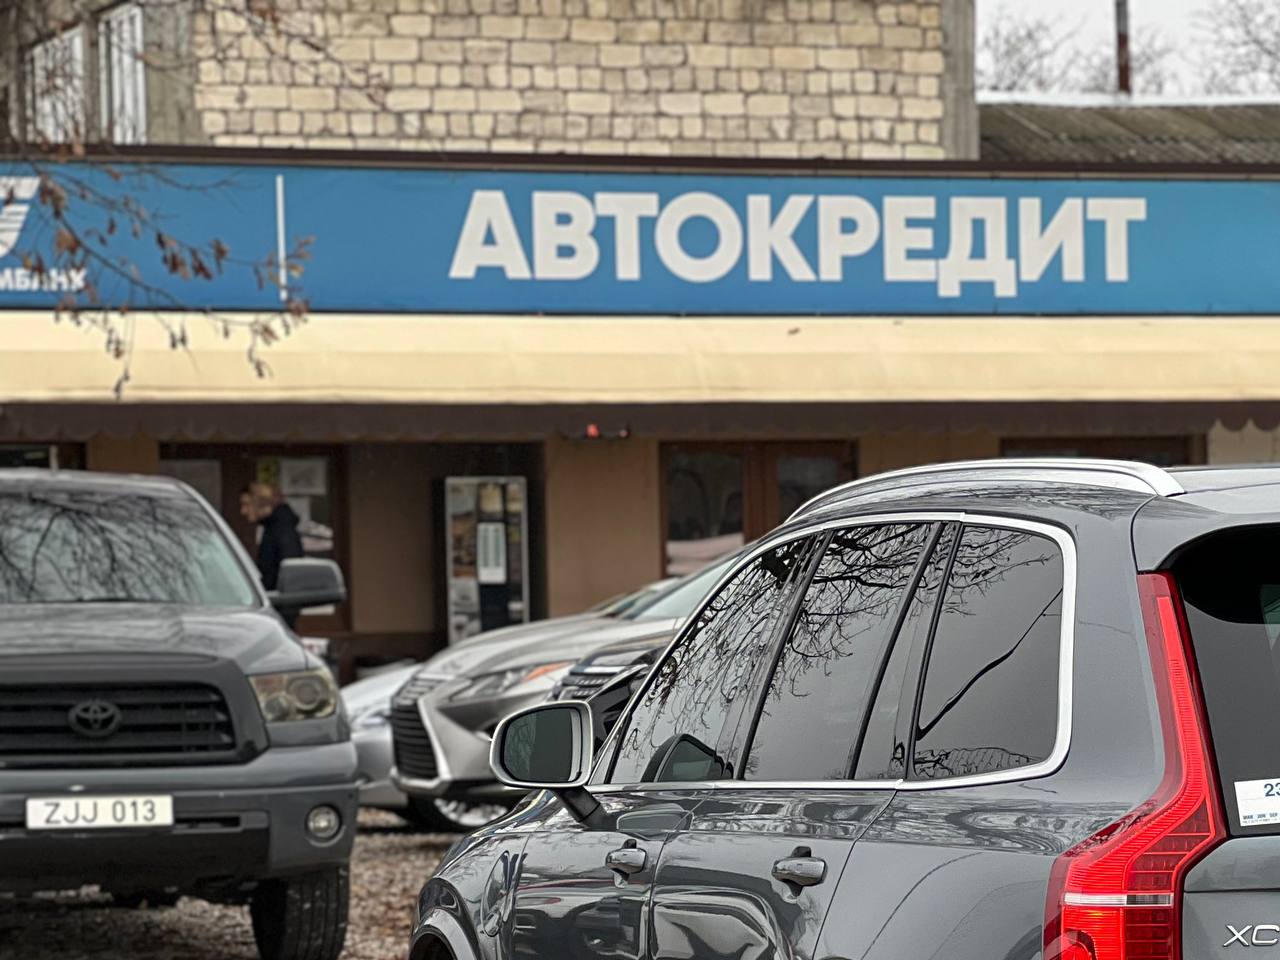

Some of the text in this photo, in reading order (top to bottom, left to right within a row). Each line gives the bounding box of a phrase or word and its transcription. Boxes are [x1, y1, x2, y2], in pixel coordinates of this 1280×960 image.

[448, 189, 1148, 297] АВТОКРЕДИТ
[44, 800, 157, 825] ZJJ 013
